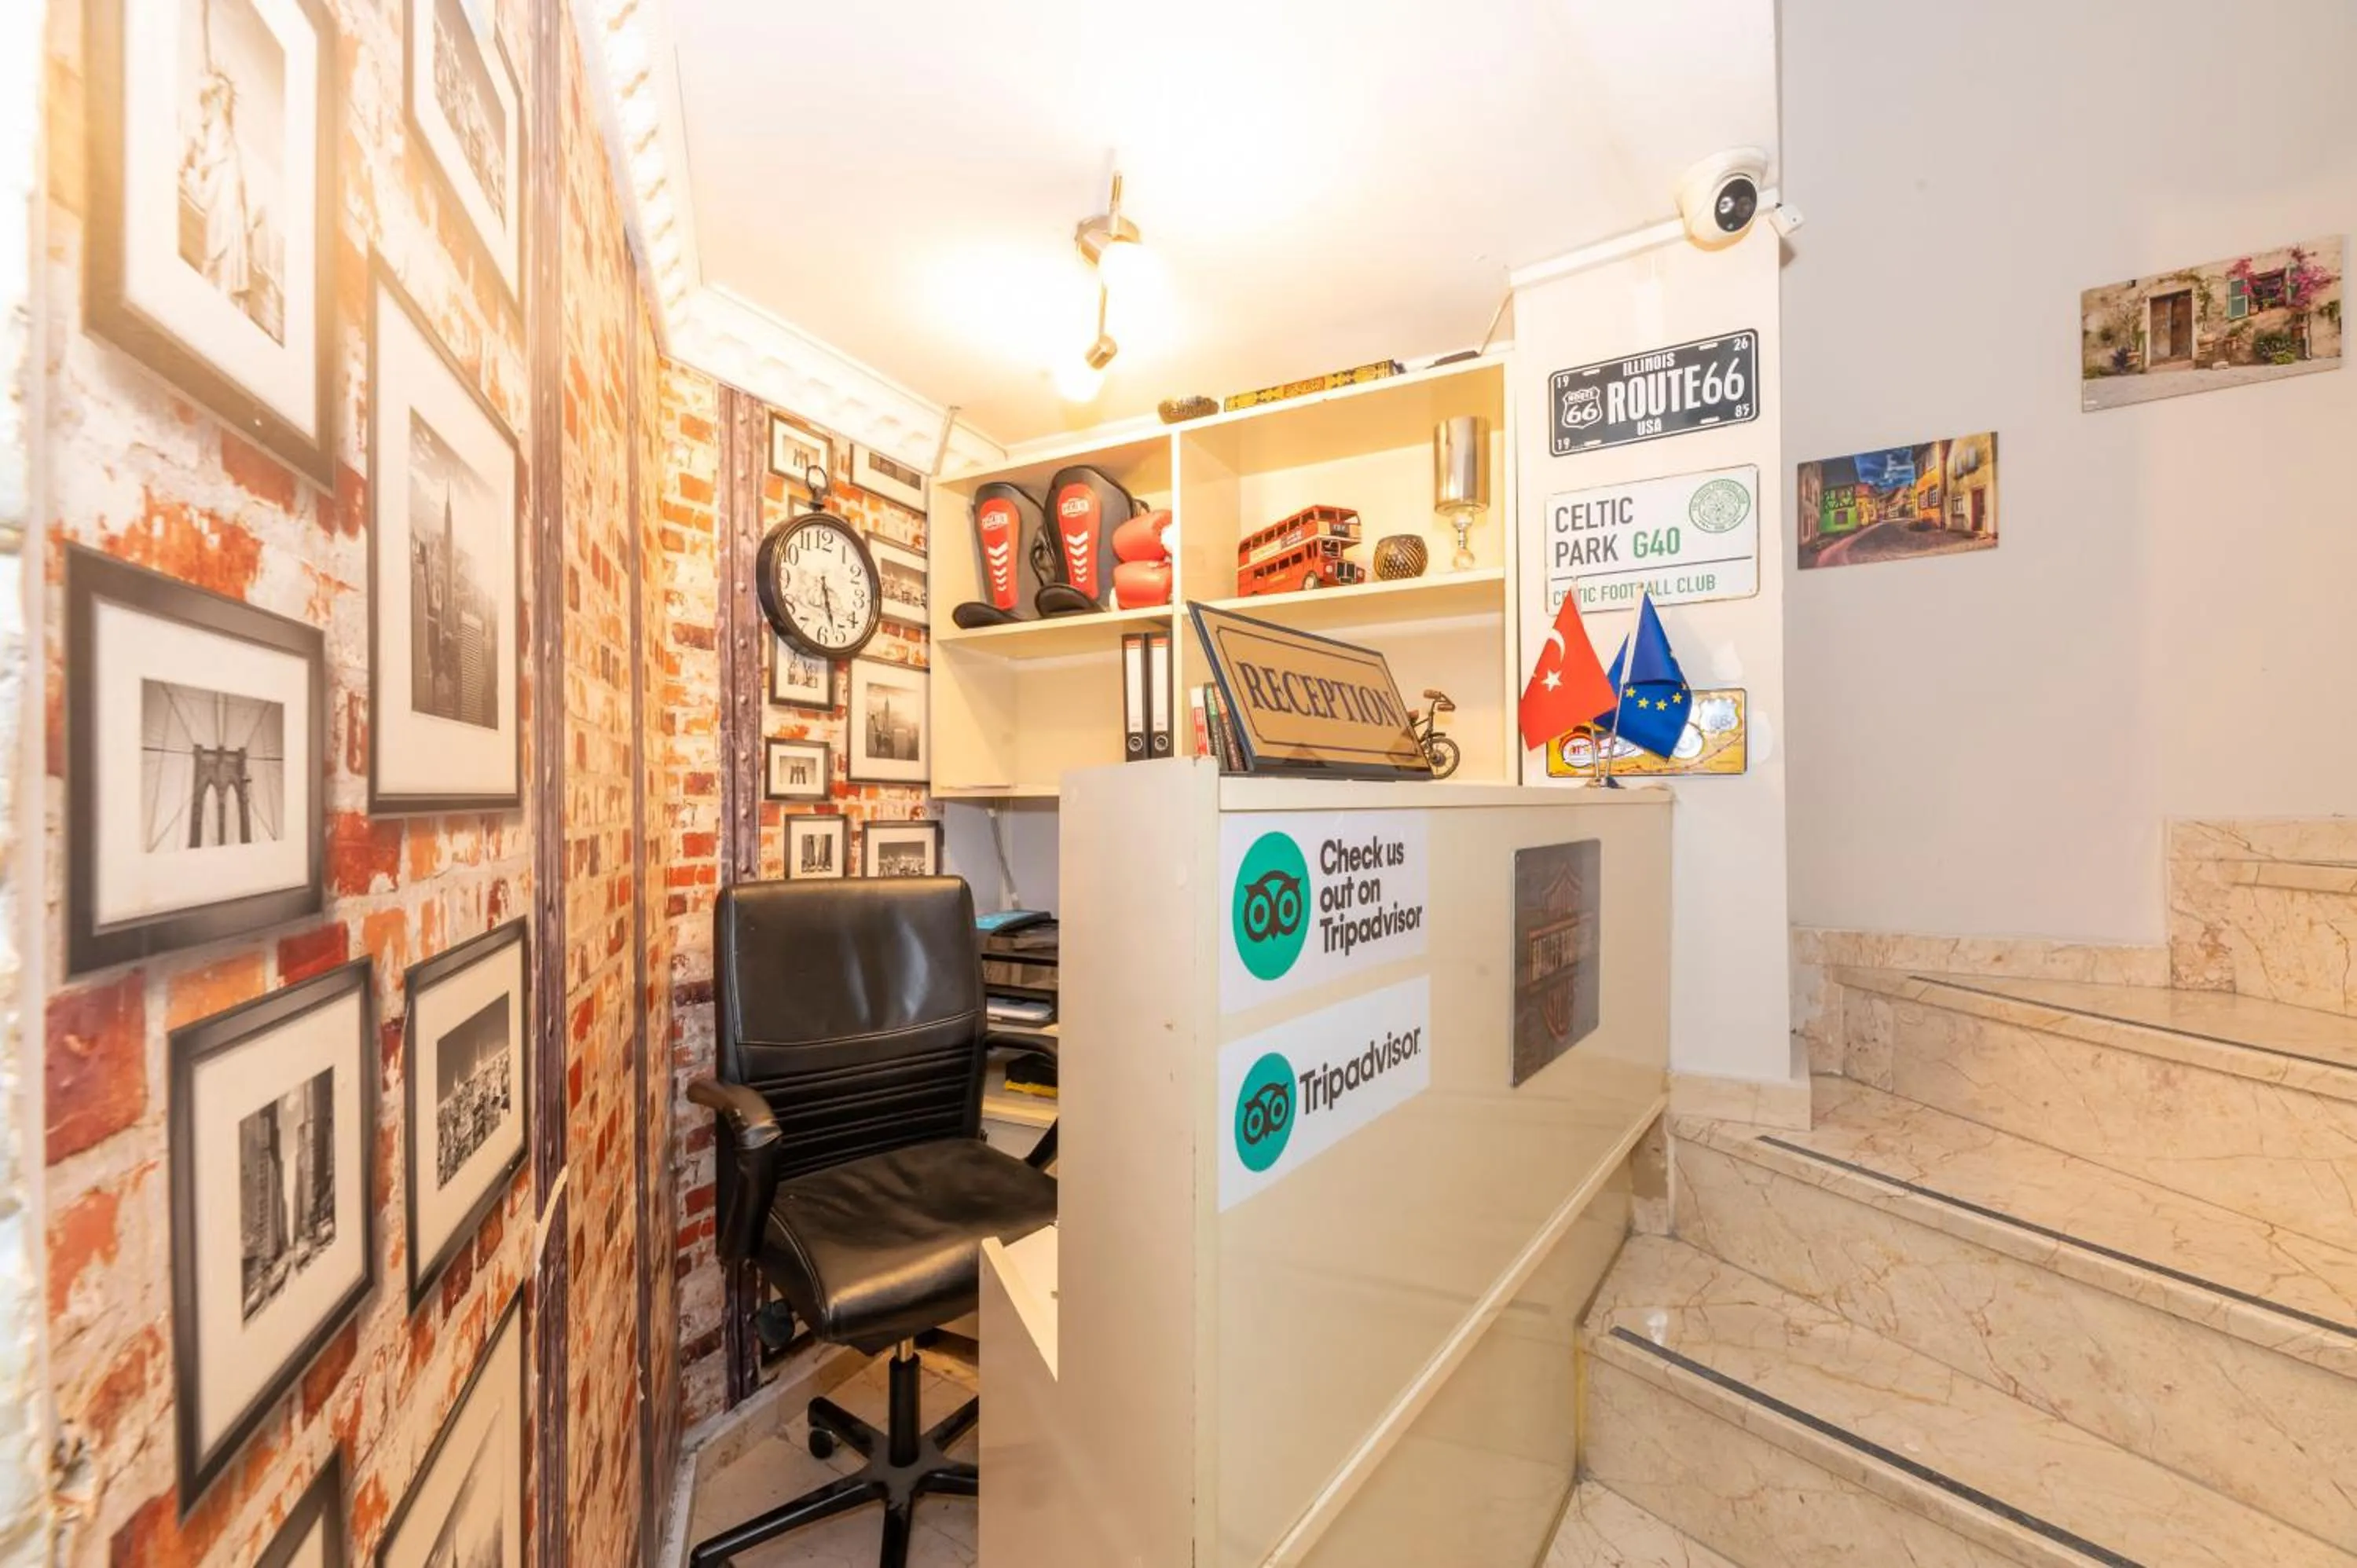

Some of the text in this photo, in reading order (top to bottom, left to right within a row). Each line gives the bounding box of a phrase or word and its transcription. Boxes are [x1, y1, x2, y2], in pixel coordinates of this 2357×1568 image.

[1734, 337, 1748, 351] 26
[1623, 352, 1675, 377] ILLINOIS
[1557, 376, 1569, 389] 19
[1566, 401, 1599, 423] 66
[1637, 418, 1662, 436] USA
[1557, 438, 1571, 450] 19
[1555, 496, 1633, 533] CELTIC
[800, 530, 811, 551] 11
[815, 529, 834, 554] 12
[1555, 526, 1681, 568] PARK G40
[850, 565, 862, 585] 2
[853, 589, 865, 610] 3
[1553, 574, 1716, 606] CTIC FOOTALL CLUB
[846, 610, 859, 629] 4
[817, 625, 828, 644] 6
[835, 624, 846, 643] 5
[1235, 661, 1402, 728] RECEPTION
[1320, 835, 1405, 876] Check us
[1320, 876, 1380, 913] out on
[1319, 900, 1423, 956] Tripadvisor
[1299, 1027, 1421, 1115] Tripadvisor
